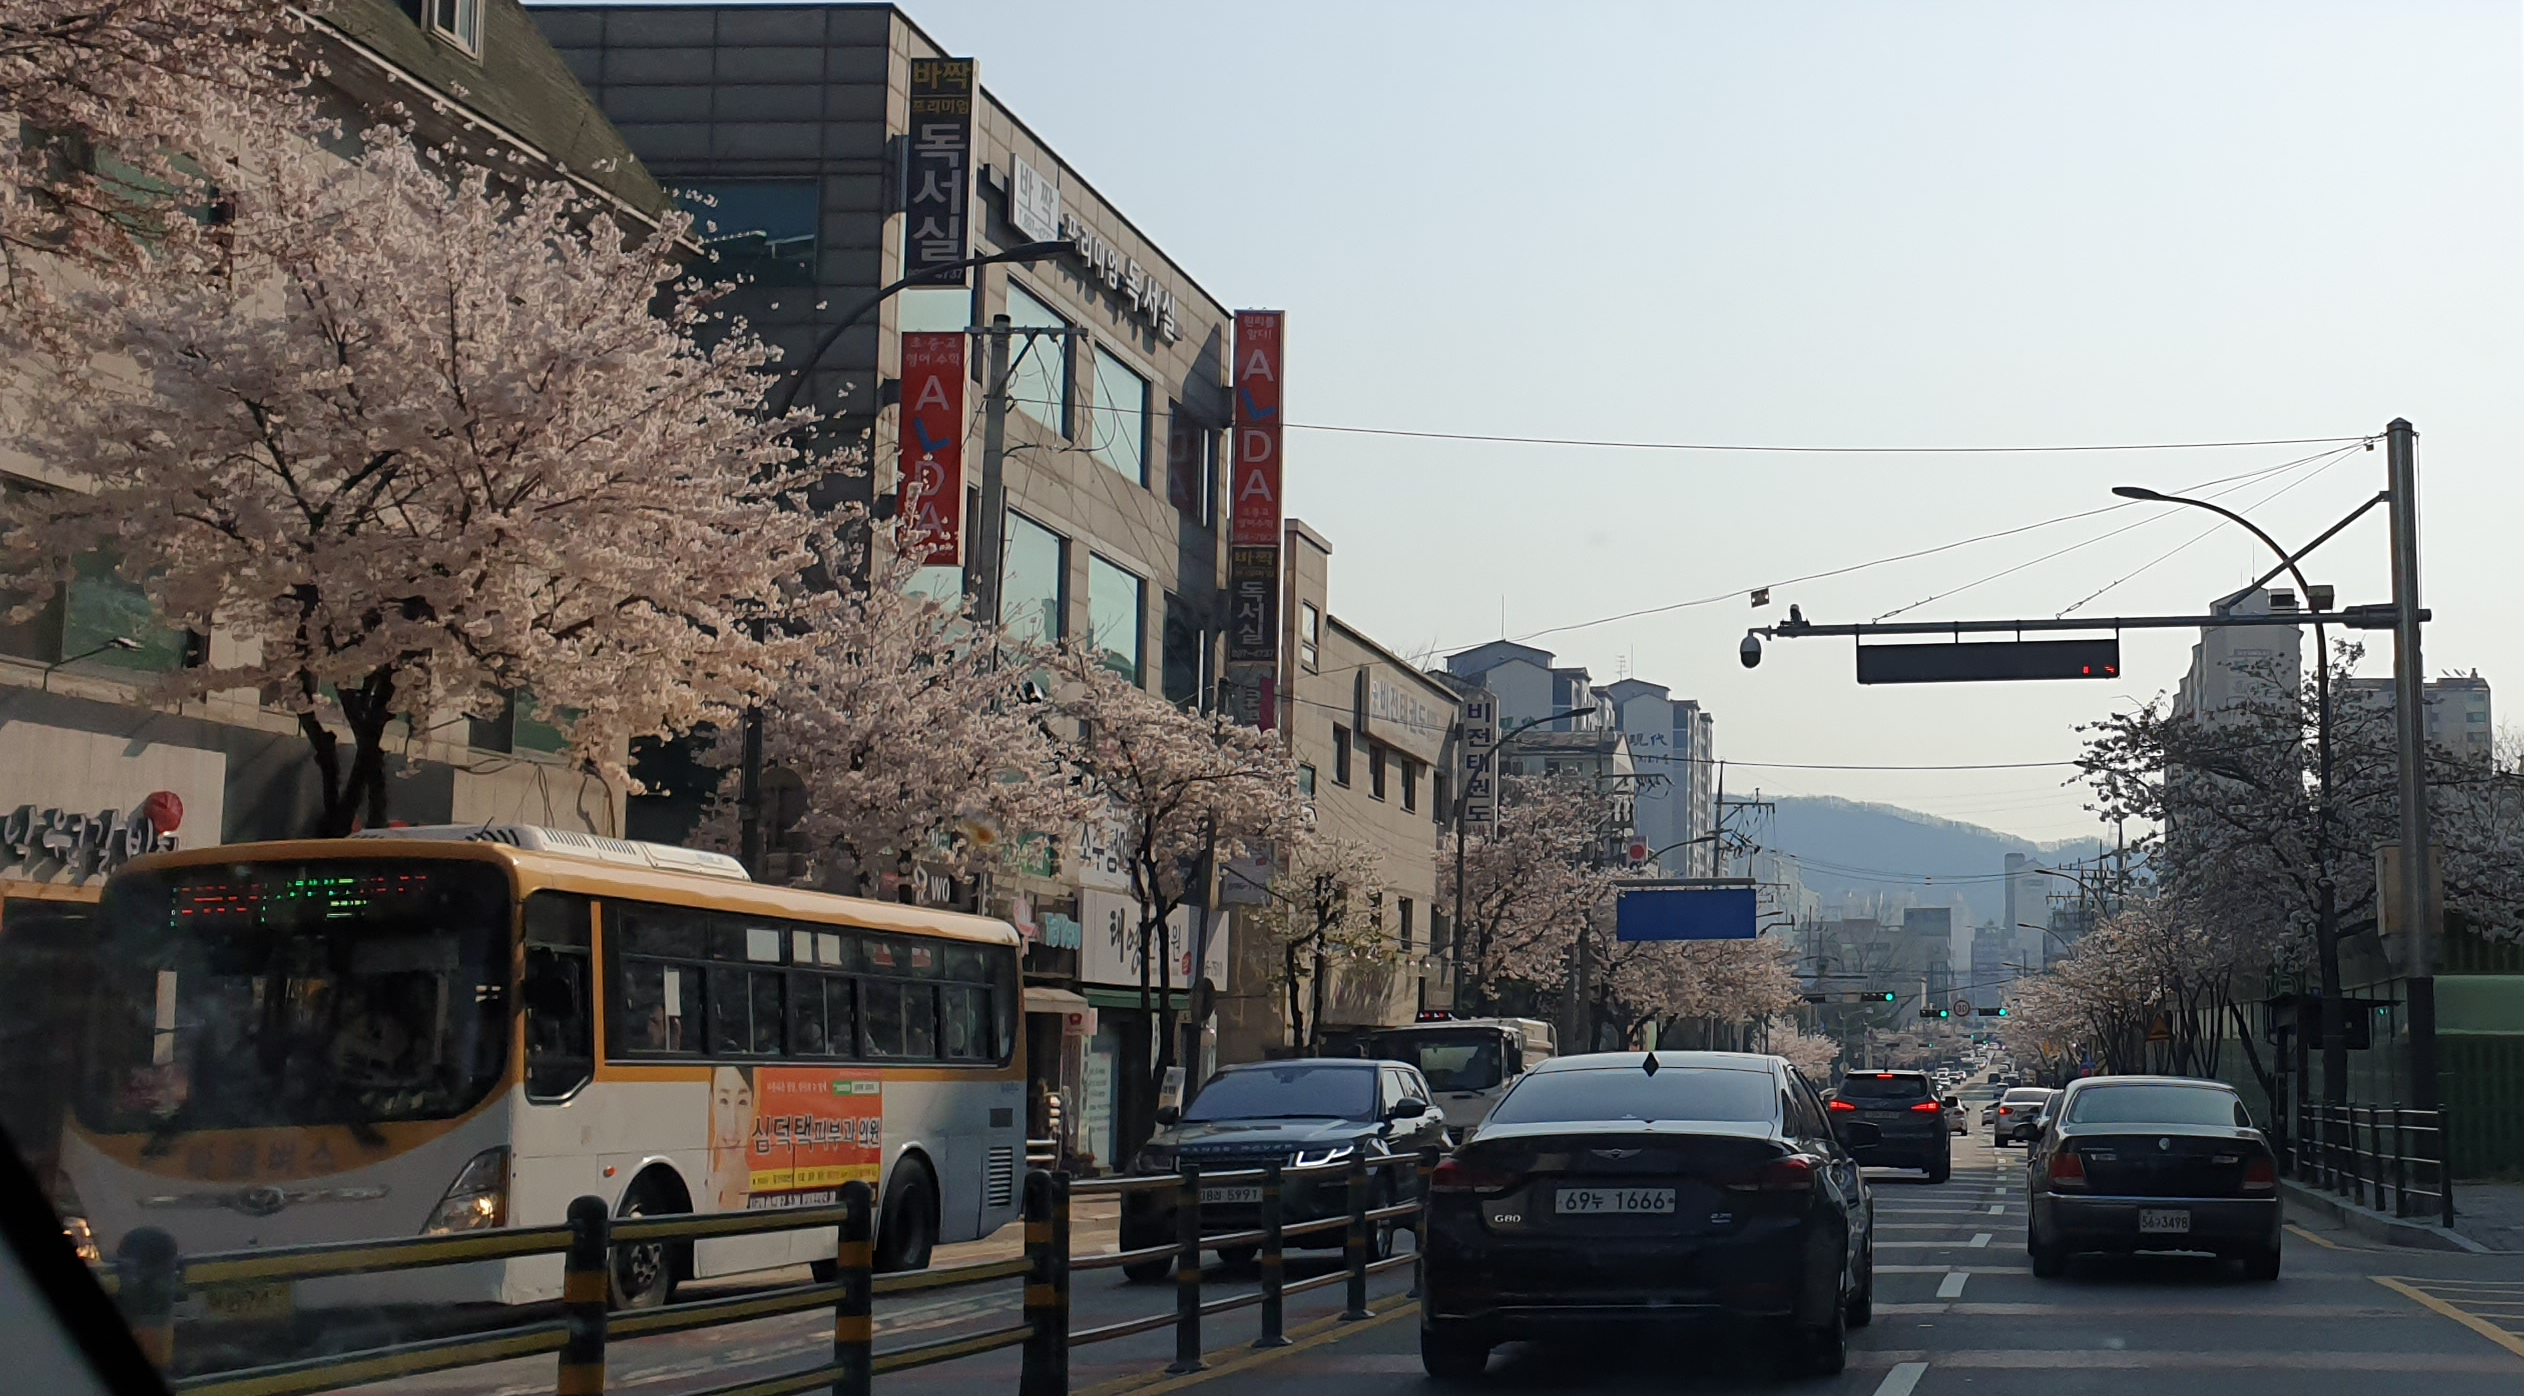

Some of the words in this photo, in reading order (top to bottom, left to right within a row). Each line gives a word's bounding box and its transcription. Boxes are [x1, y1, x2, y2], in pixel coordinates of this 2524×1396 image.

[913, 62, 971, 90] 바짝
[913, 99, 969, 115] 프리미엄
[912, 122, 966, 262] 독서실
[1020, 162, 1054, 229] 바짝
[1126, 258, 1177, 342] 독서실
[1240, 348, 1277, 502] ALDA
[1238, 581, 1267, 645] 독서실
[1465, 702, 1493, 823] 비전태권도
[1227, 1188, 1257, 1201] 5991
[1494, 1214, 1522, 1223] G80
[1615, 1191, 1665, 1210] 1666
